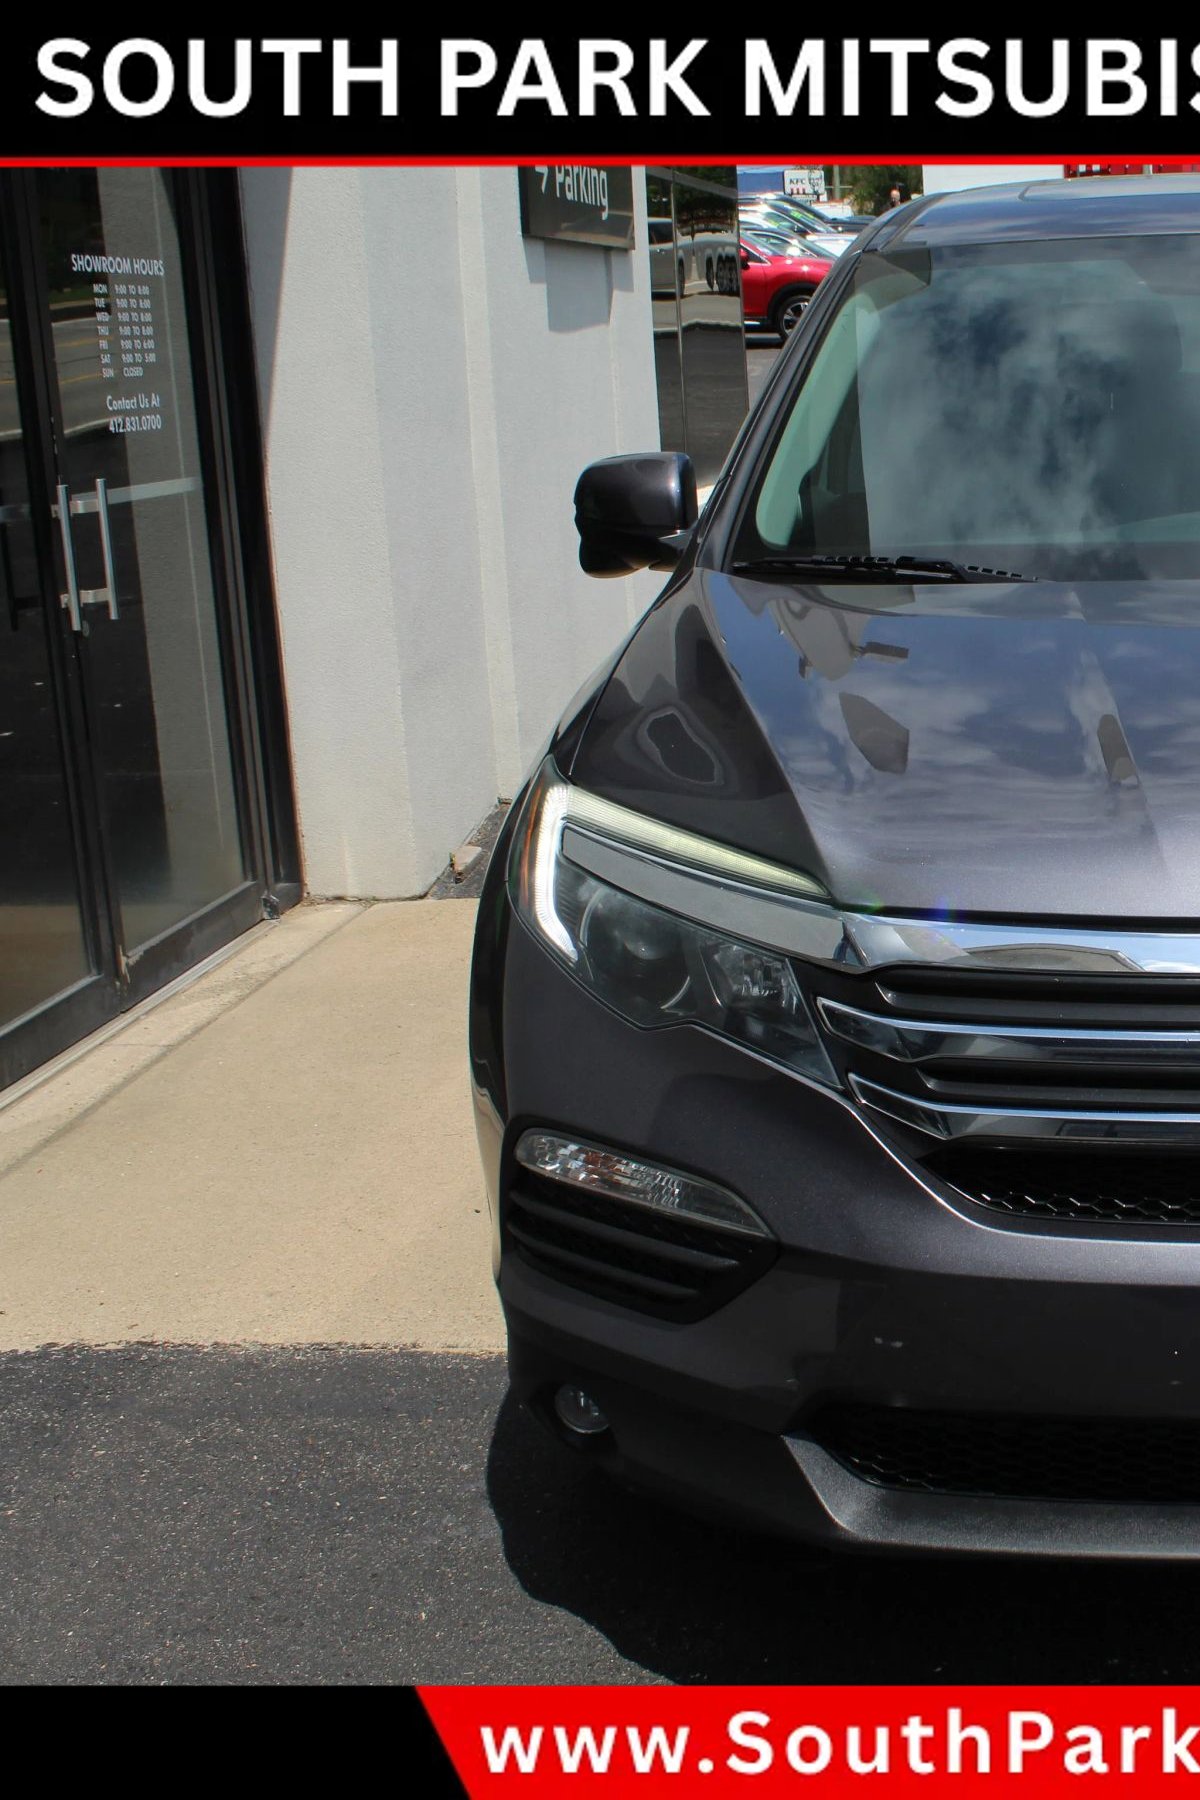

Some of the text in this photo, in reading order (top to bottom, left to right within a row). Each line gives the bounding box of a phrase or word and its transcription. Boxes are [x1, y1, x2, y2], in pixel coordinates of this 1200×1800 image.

[71, 253, 165, 276] SHOWROOM HOURS
[123, 367, 144, 377] CLOSED
[106, 392, 161, 412] Contact Us At
[109, 414, 162, 434] 412.831.0700
